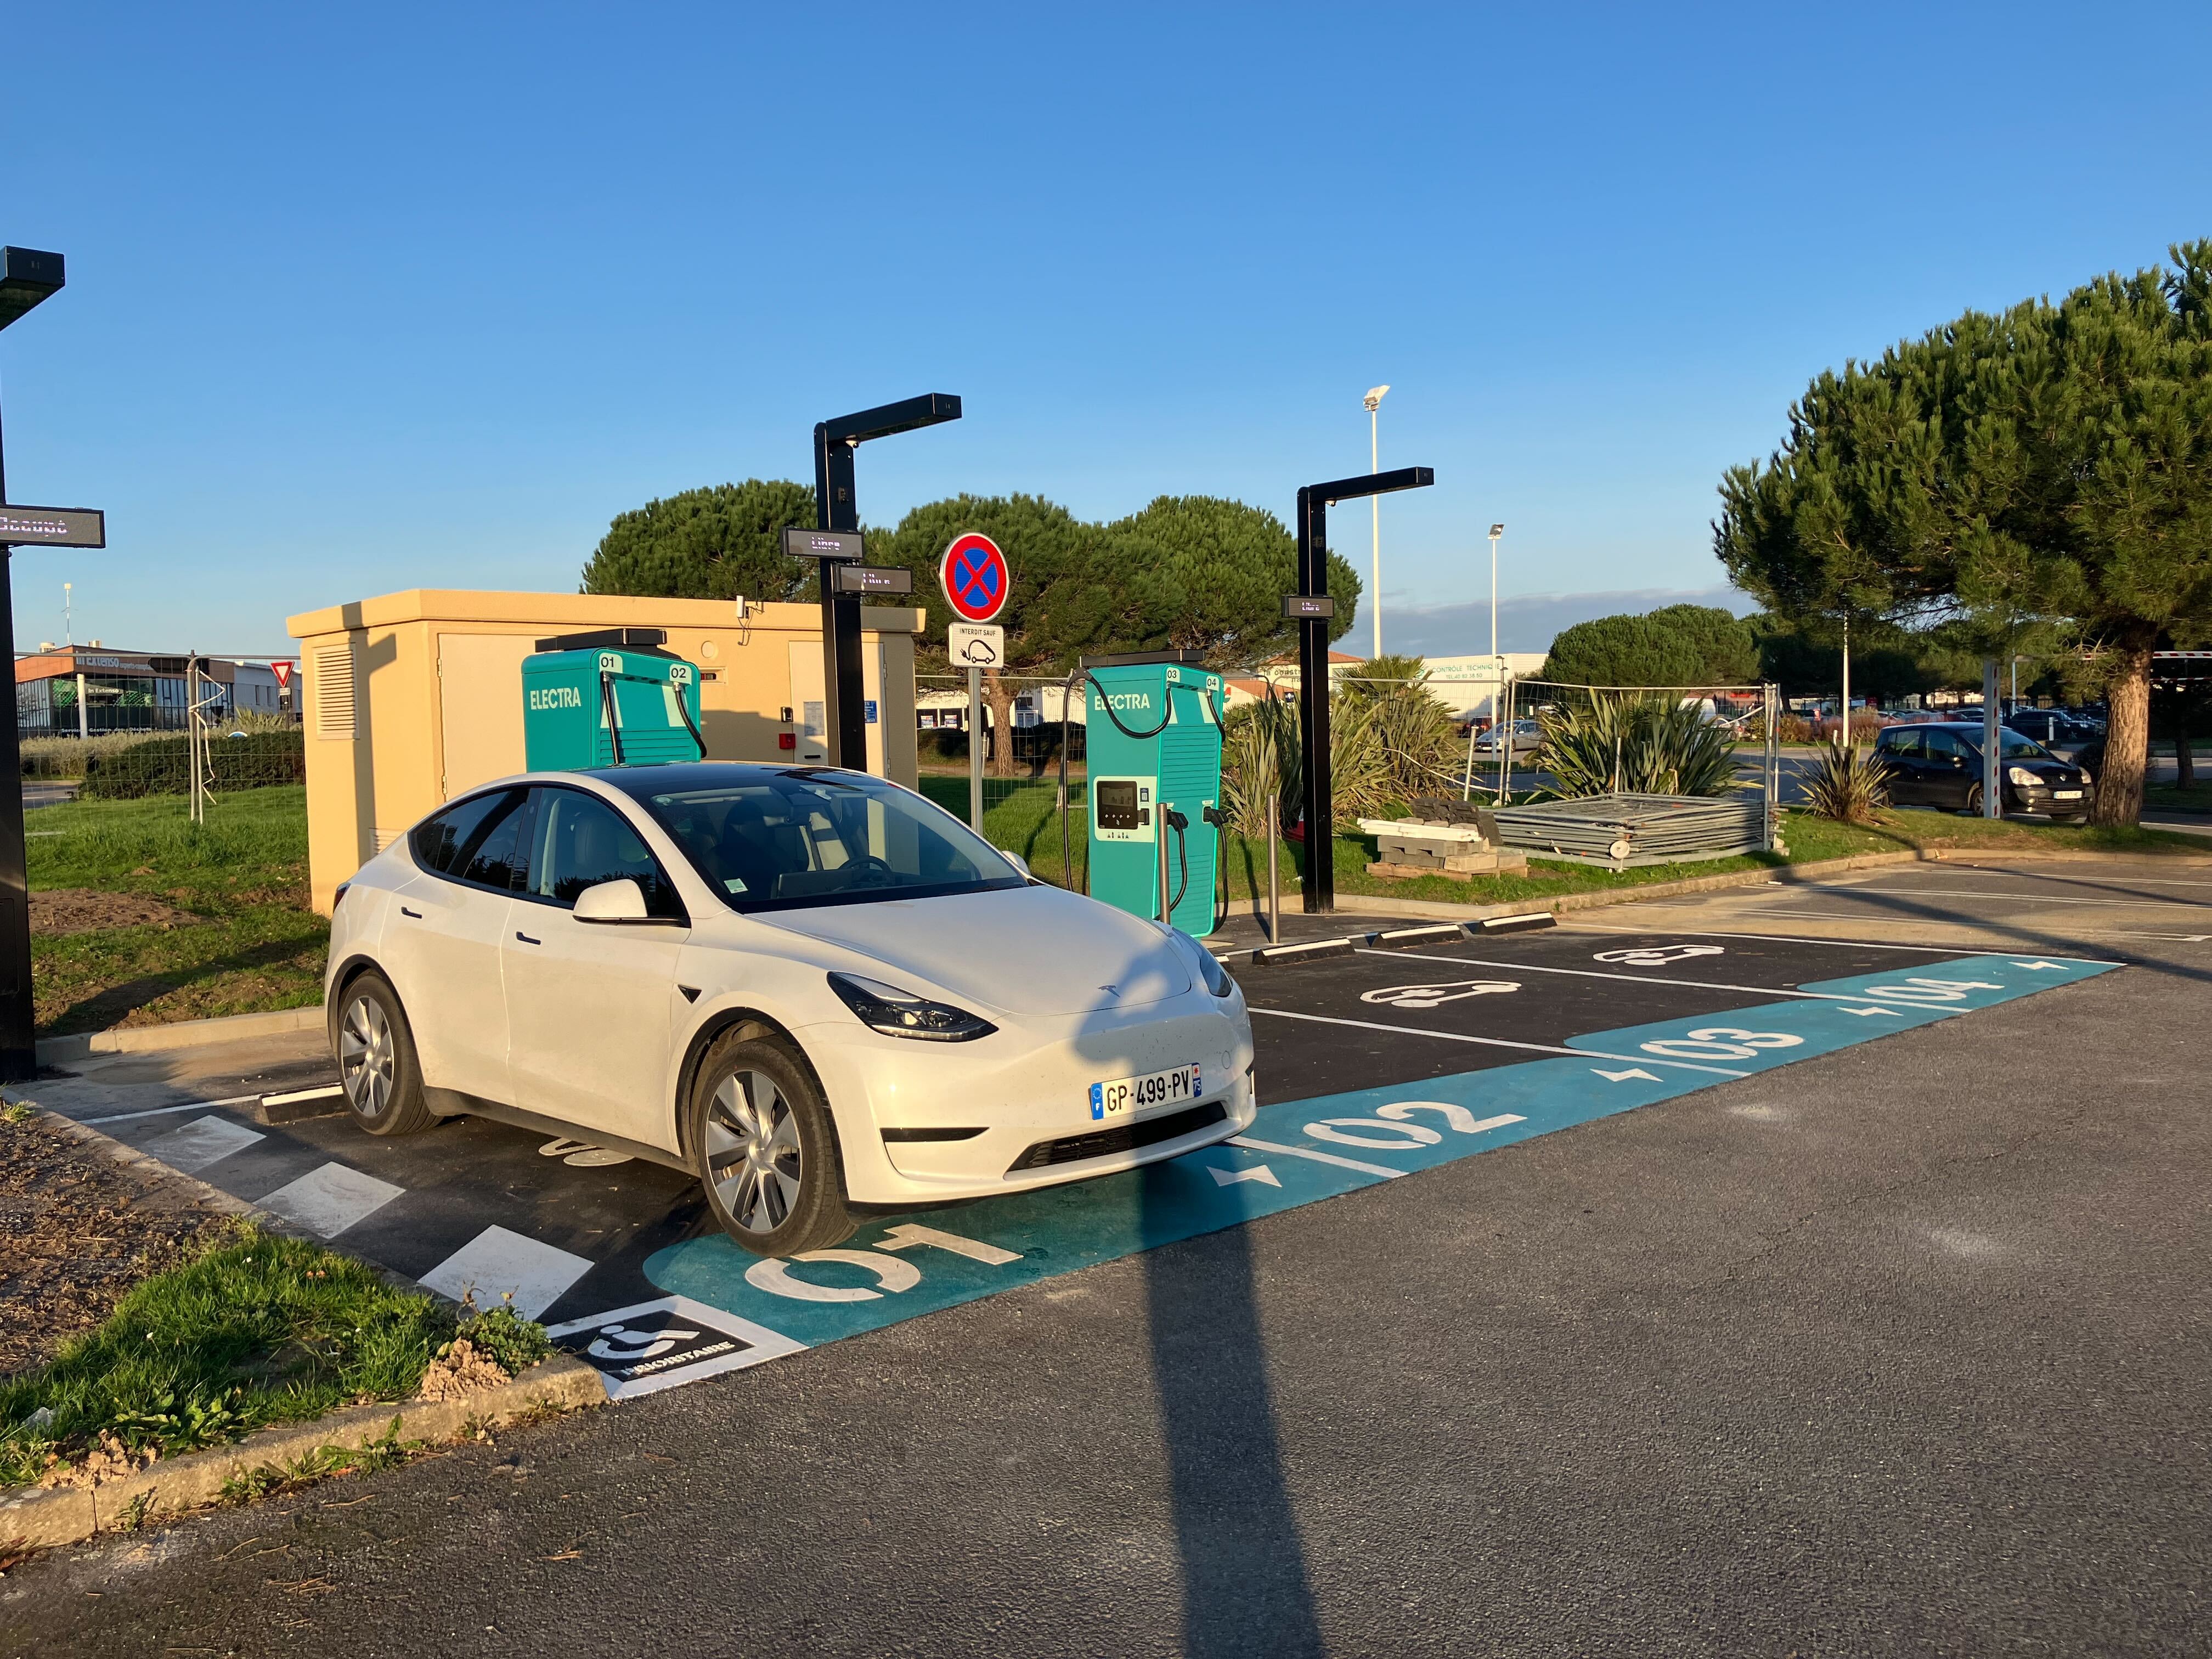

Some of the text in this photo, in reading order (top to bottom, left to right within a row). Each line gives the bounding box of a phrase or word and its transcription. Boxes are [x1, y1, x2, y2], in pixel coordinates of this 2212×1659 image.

[601, 657, 614, 668] 01
[671, 668, 686, 678] 02
[1207, 678, 1216, 686] 04
[530, 687, 582, 710] ELECTRA
[1094, 693, 1150, 710] ELECTRA
[1864, 978, 2005, 1001] 04
[1640, 1028, 1804, 1060] 03
[1107, 1070, 1189, 1111] GP-499-PV
[1193, 1079, 1201, 1092] 75
[1302, 1101, 1528, 1150] 02
[744, 1223, 1024, 1302] 01
[620, 1341, 735, 1376] PRIORITAIRE
